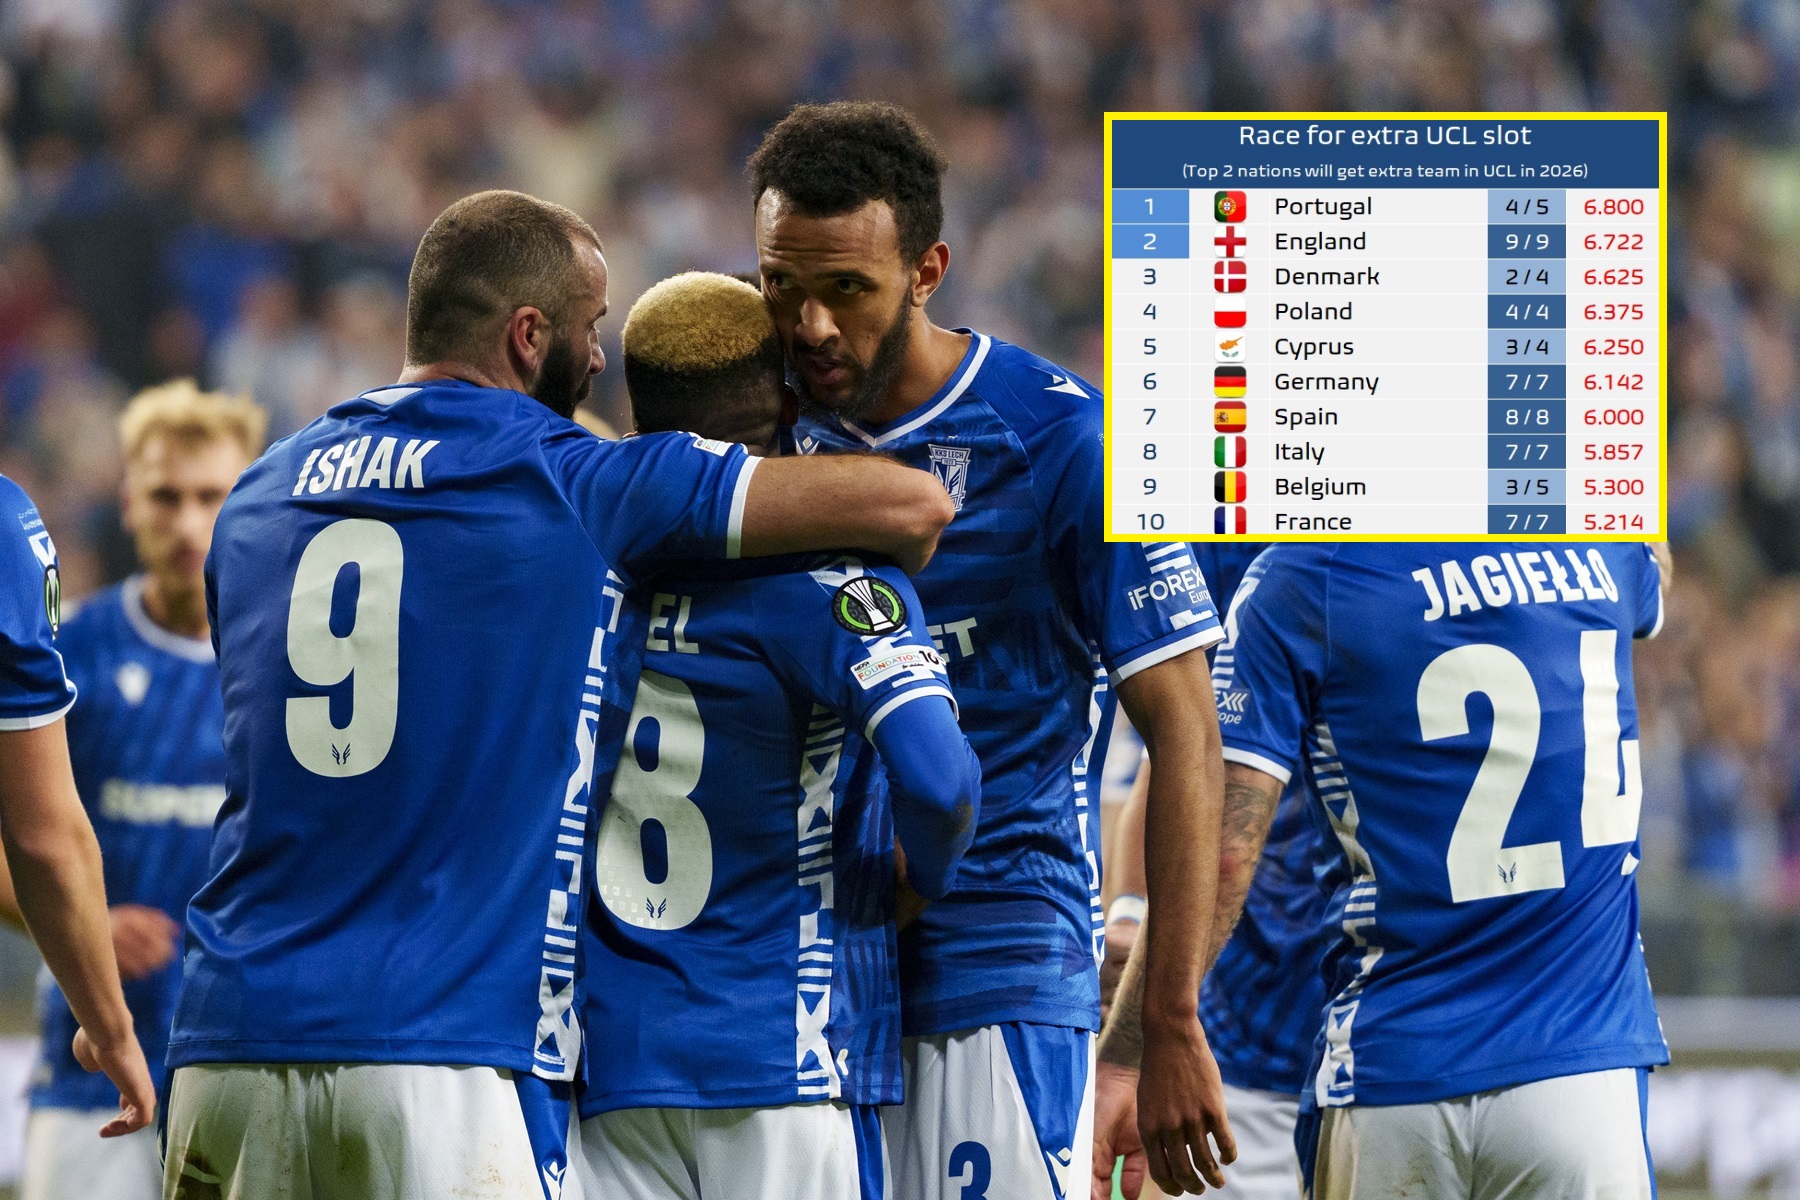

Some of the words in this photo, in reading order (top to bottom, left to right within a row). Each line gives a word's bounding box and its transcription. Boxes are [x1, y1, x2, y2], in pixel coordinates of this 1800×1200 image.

[292, 435, 440, 496] ISHAK
[948, 451, 964, 459] LECH
[1412, 549, 1618, 621] JAGIEŁŁO
[286, 518, 404, 777] 9
[646, 593, 699, 654] EL
[857, 653, 920, 680] FOUNDATION
[1217, 711, 1242, 725] ope
[1417, 630, 1643, 904] 24
[596, 669, 713, 931] 8
[948, 1141, 992, 1200] 3
